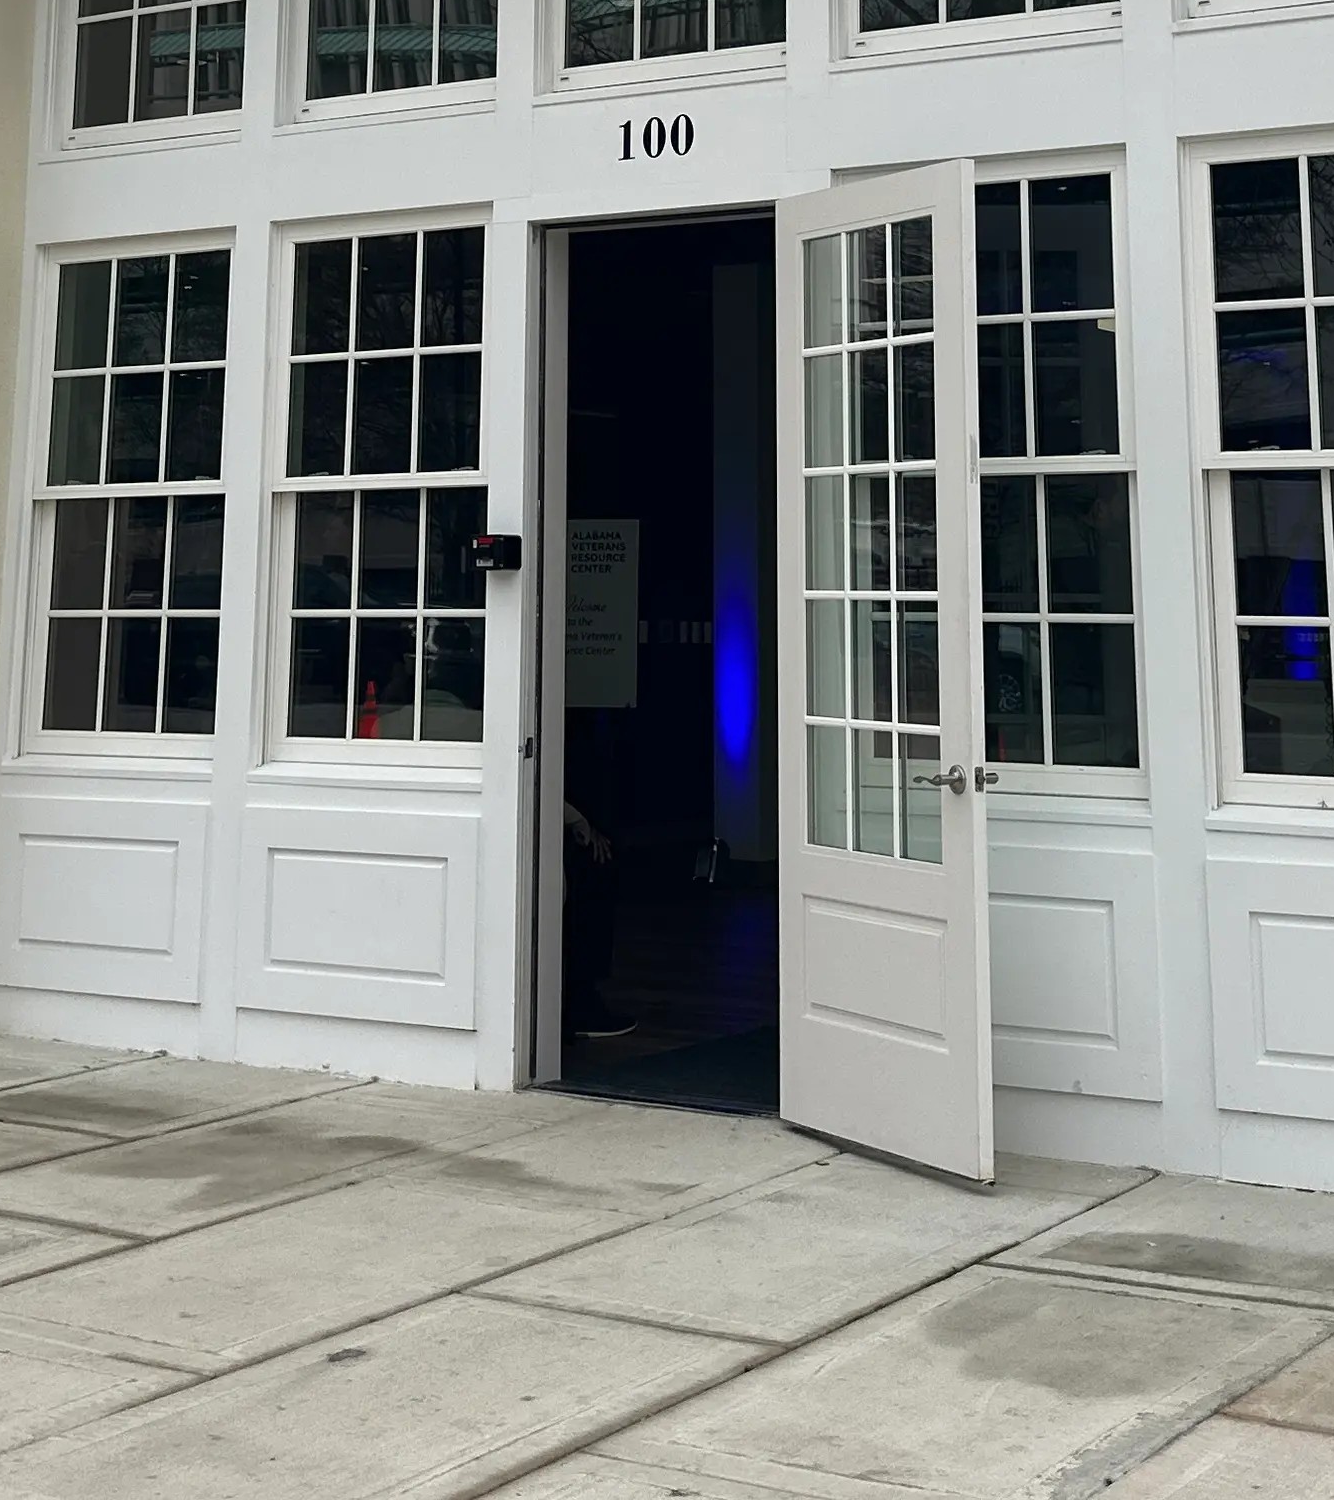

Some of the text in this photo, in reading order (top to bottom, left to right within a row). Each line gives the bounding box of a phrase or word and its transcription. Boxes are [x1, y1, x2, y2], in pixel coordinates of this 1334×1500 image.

[618, 113, 695, 160] 100
[571, 531, 622, 540] ALABAMA
[571, 542, 626, 551] VETERANS
[571, 553, 625, 562] RESOURCE
[571, 564, 612, 573] CENTER
